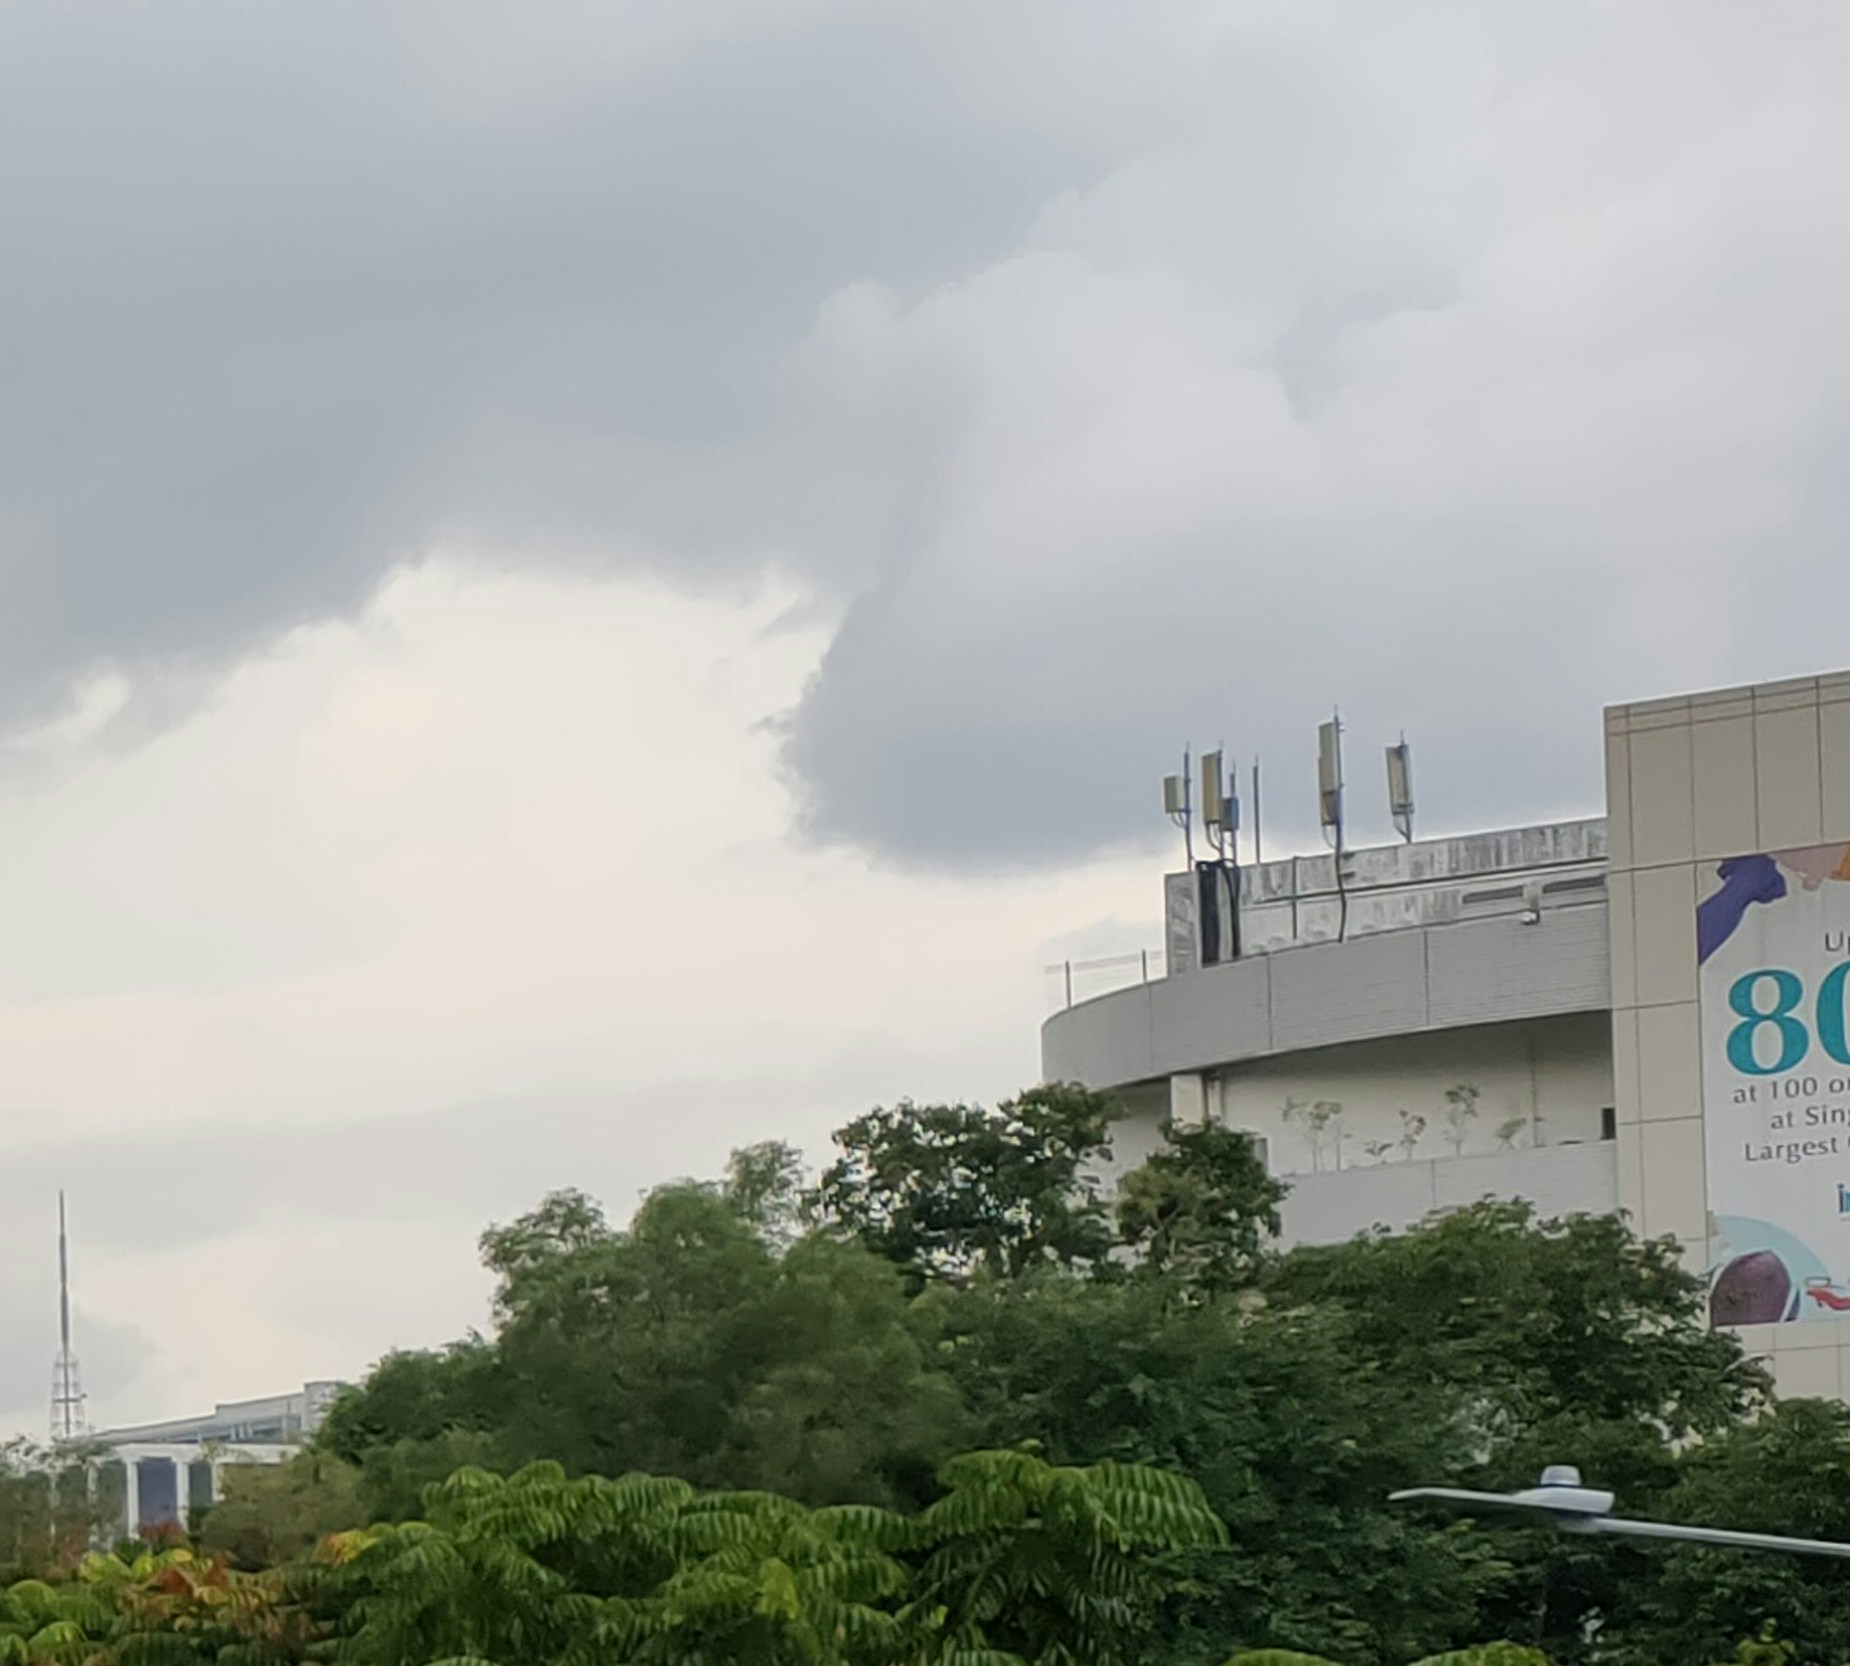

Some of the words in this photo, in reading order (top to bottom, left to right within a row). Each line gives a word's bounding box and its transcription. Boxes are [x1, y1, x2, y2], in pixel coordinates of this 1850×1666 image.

[1824, 931, 1850, 953] U
[1733, 1086, 1757, 1104] at
[1770, 1078, 1818, 1098] 100
[1828, 1079, 1850, 1093] o
[1770, 1113, 1795, 1130] at
[1744, 1138, 1839, 1164] Largest
